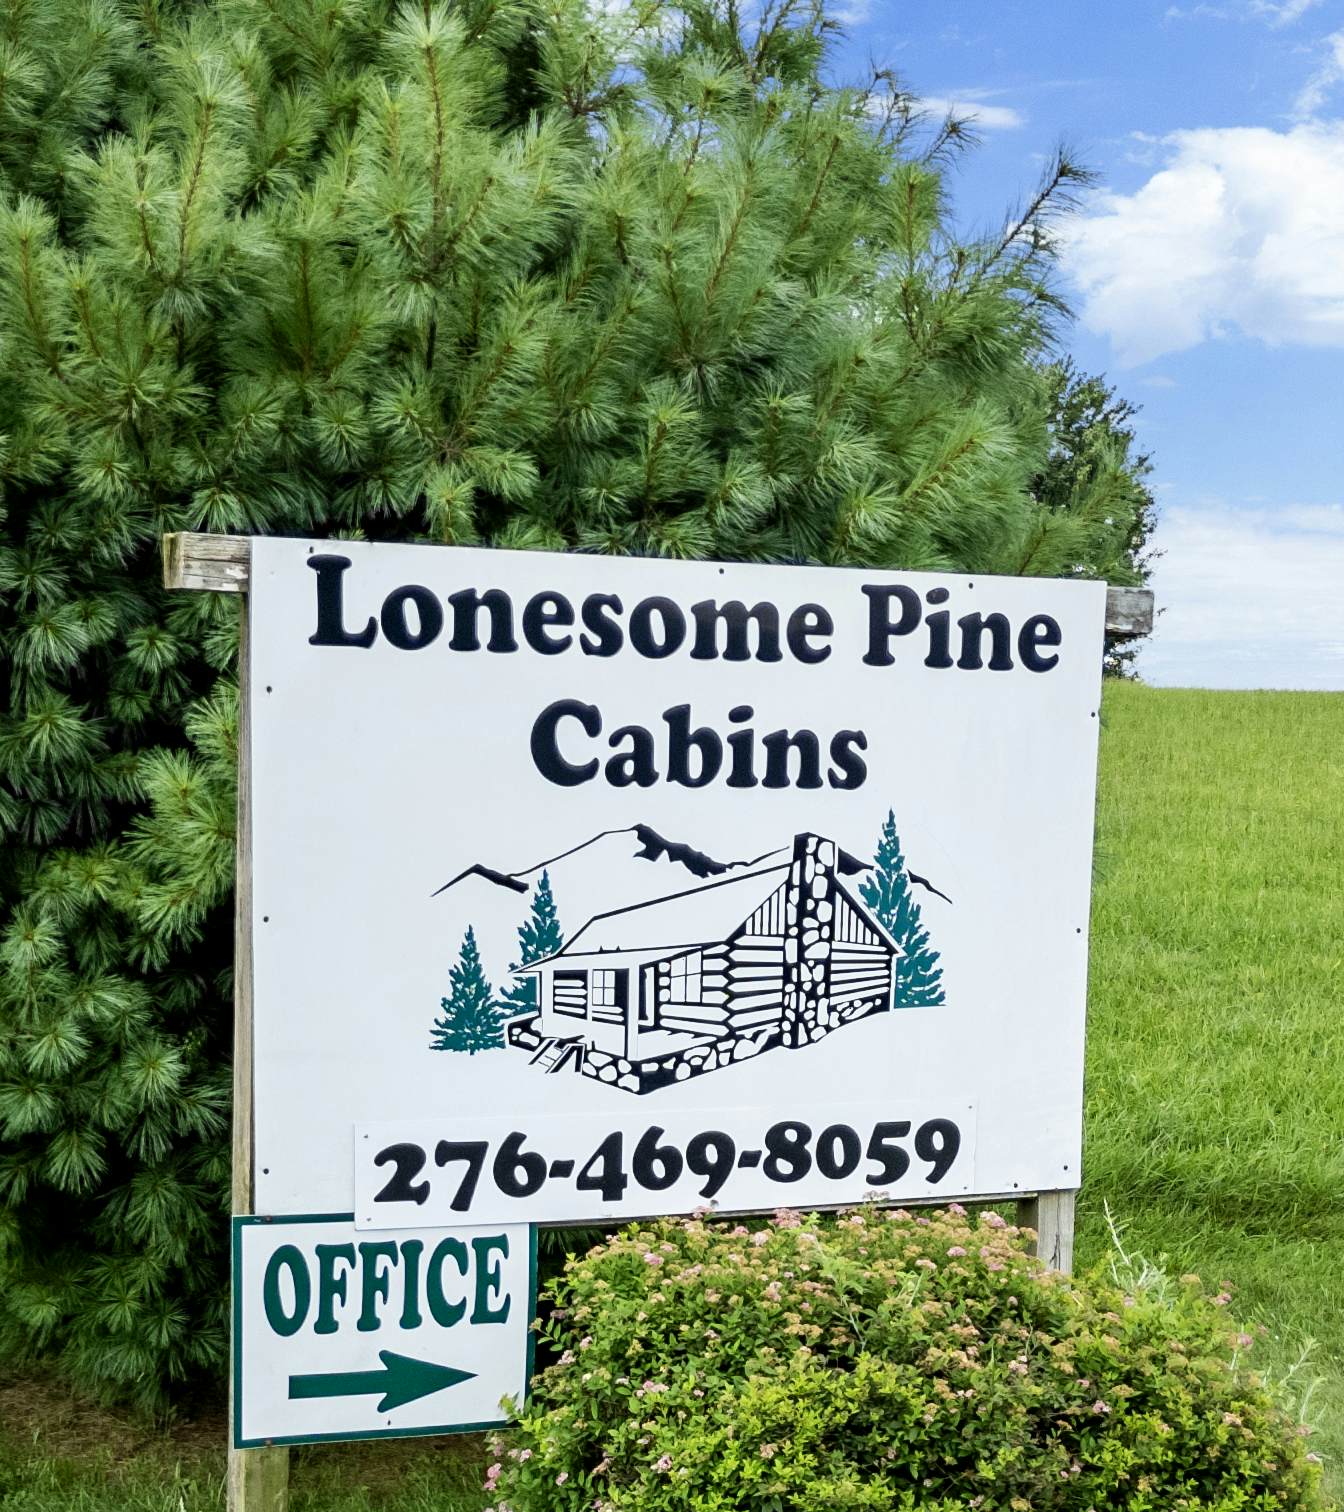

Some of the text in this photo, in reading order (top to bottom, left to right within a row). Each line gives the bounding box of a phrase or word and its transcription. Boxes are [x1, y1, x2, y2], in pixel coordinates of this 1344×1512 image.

[305, 553, 1063, 675] Lonesome Pine
[529, 697, 869, 792] Cabins
[372, 1117, 962, 1213] 276-469-8059
[262, 1232, 512, 1338] OFFICE
